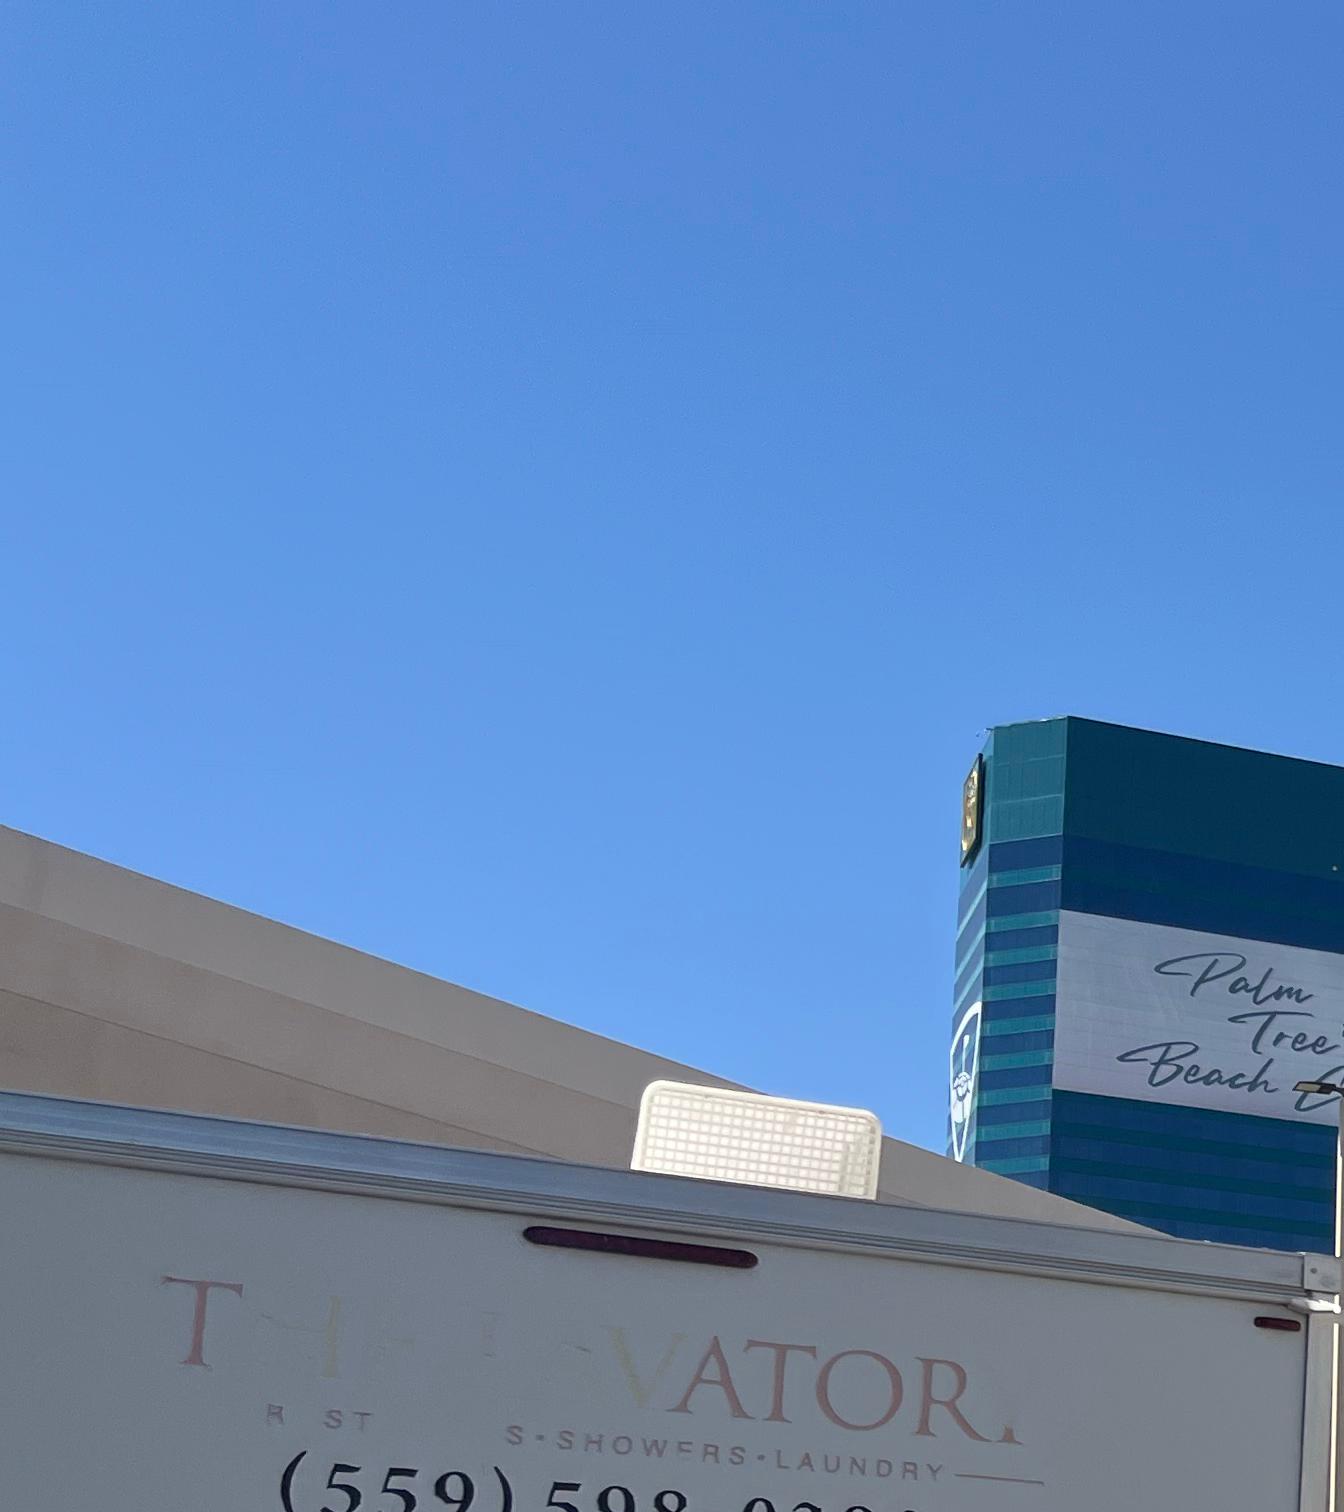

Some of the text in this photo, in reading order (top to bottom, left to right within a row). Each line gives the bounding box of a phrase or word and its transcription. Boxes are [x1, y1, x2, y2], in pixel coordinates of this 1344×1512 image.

[1153, 953, 1314, 1005] Palm
[1227, 1011, 1341, 1055] Tree
[1115, 1041, 1280, 1094] Beach
